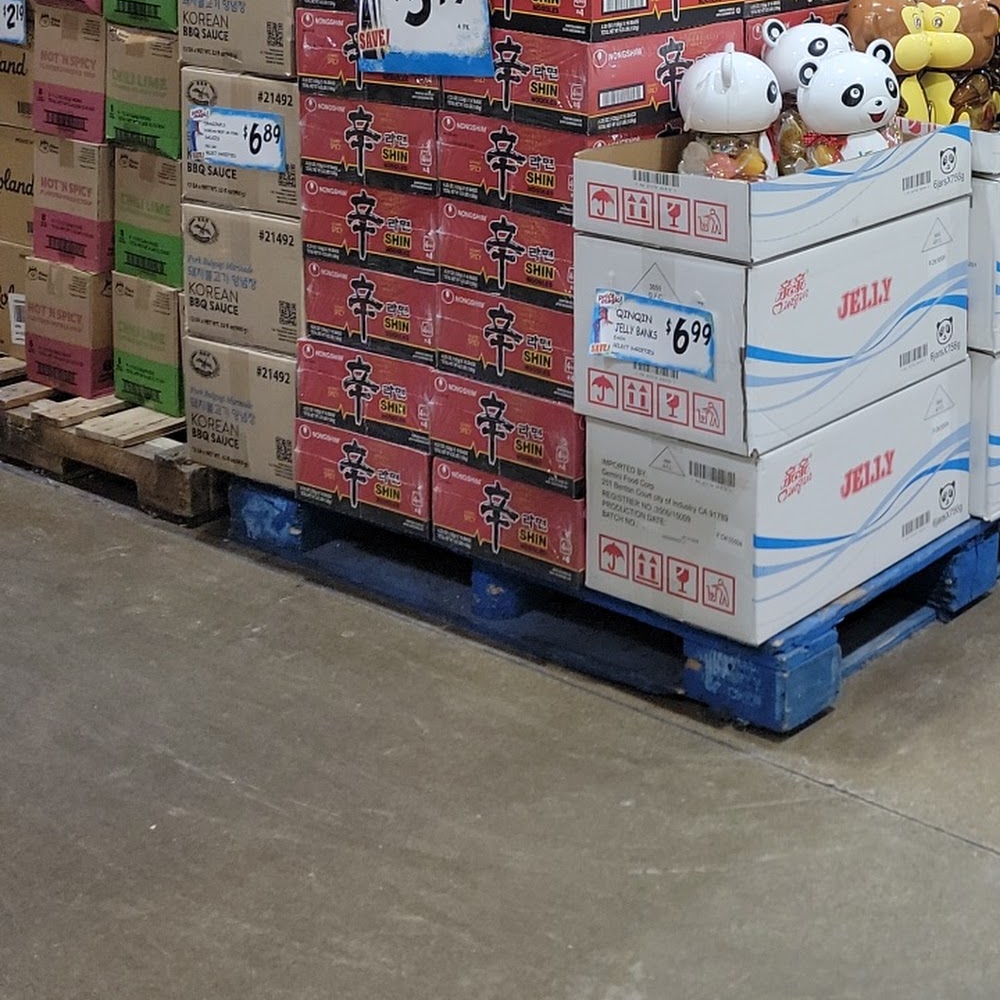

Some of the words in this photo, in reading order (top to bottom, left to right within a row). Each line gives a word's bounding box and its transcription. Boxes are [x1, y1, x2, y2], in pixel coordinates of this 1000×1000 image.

[183, 11, 229, 29] KOREAN
[183, 26, 200, 40] BBQ
[202, 29, 229, 42] SAUCE
[358, 28, 390, 50] SAVE!
[258, 91, 294, 107] #21492
[243, 123, 281, 155] $689
[187, 162, 206, 175] BBQ
[207, 165, 237, 179] SAUCE
[485, 126, 526, 200] 辛
[529, 155, 556, 170] 라면
[526, 171, 556, 187] SHIN
[259, 230, 295, 247] #21492
[188, 282, 239, 303] KOREAN
[837, 276, 893, 321] JELLY
[189, 297, 208, 311] BBQ
[209, 300, 239, 315] SAUCE
[616, 308, 653, 323] QINQIN
[614, 322, 634, 335] JELLY
[635, 325, 658, 340] BANKS
[665, 317, 712, 355] $699
[257, 366, 291, 384] #21492
[342, 355, 380, 425] 辛
[382, 385, 406, 399] 라면
[379, 400, 407, 416] SHIN
[191, 413, 239, 436] KOREAN
[475, 391, 515, 465] 辛
[516, 423, 543, 439] 라면
[191, 428, 209, 440] BBQ
[210, 433, 239, 450] SAUCE
[515, 439, 544, 457] SHIN
[840, 449, 896, 499] JELLY
